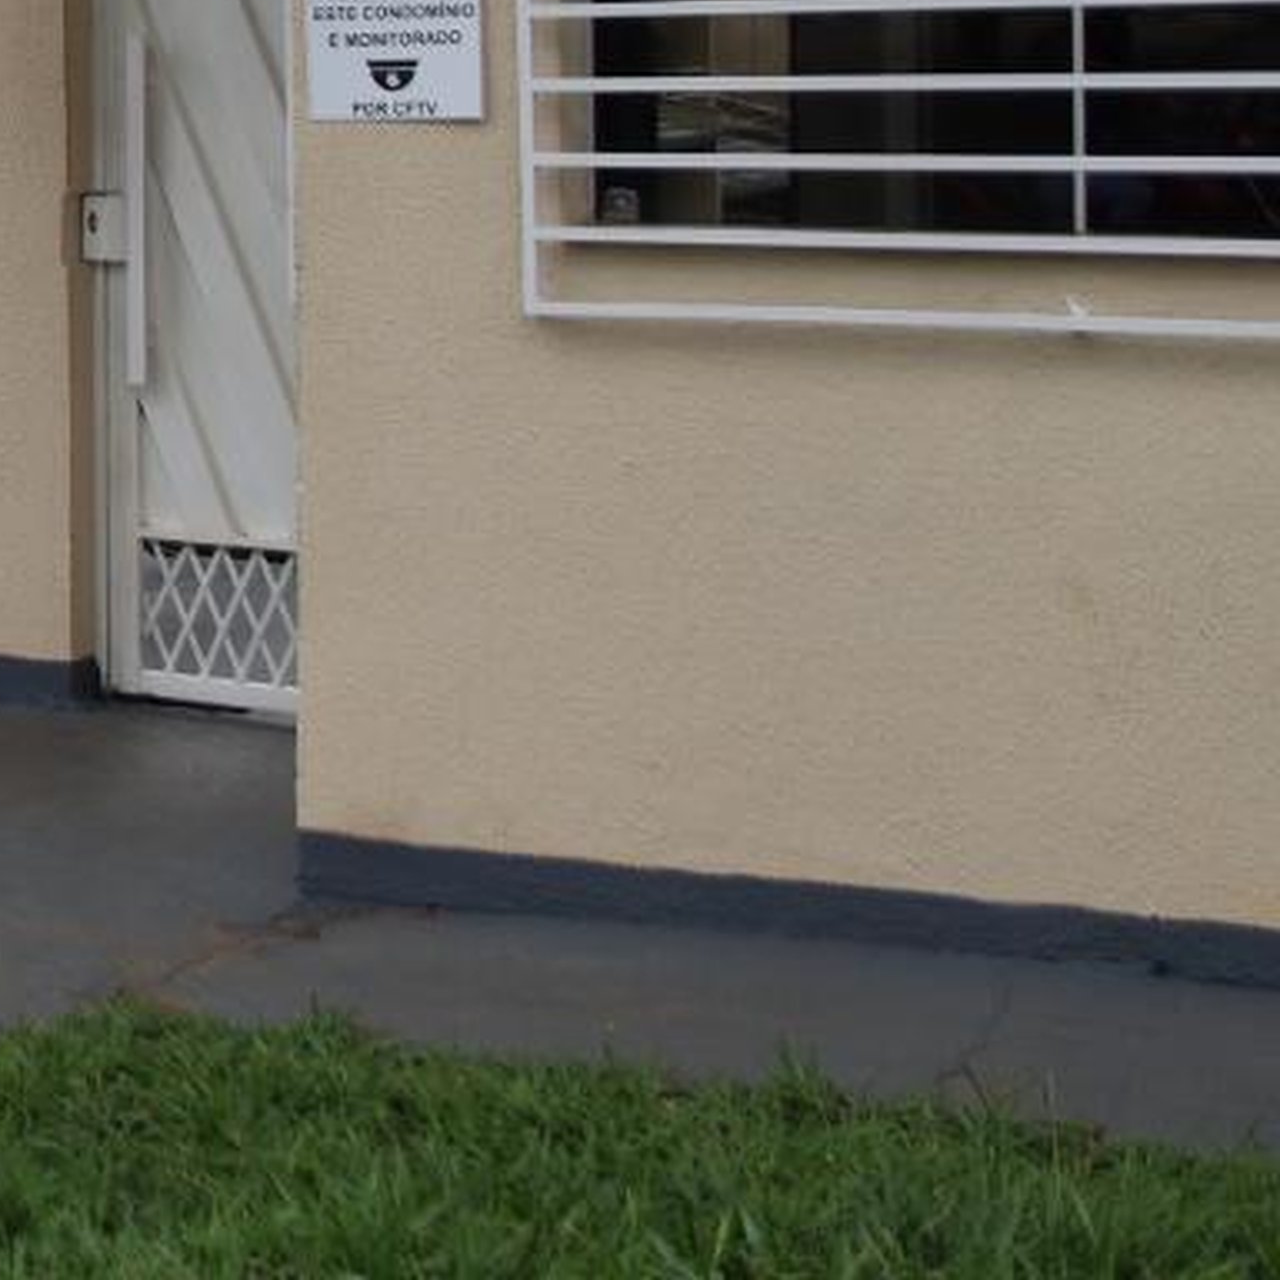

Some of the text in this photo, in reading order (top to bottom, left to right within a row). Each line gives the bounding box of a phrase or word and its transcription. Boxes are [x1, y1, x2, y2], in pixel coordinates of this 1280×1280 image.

[312, 4, 357, 21] ESTE
[345, 29, 462, 48] MONITORADO
[352, 102, 389, 117] POR
